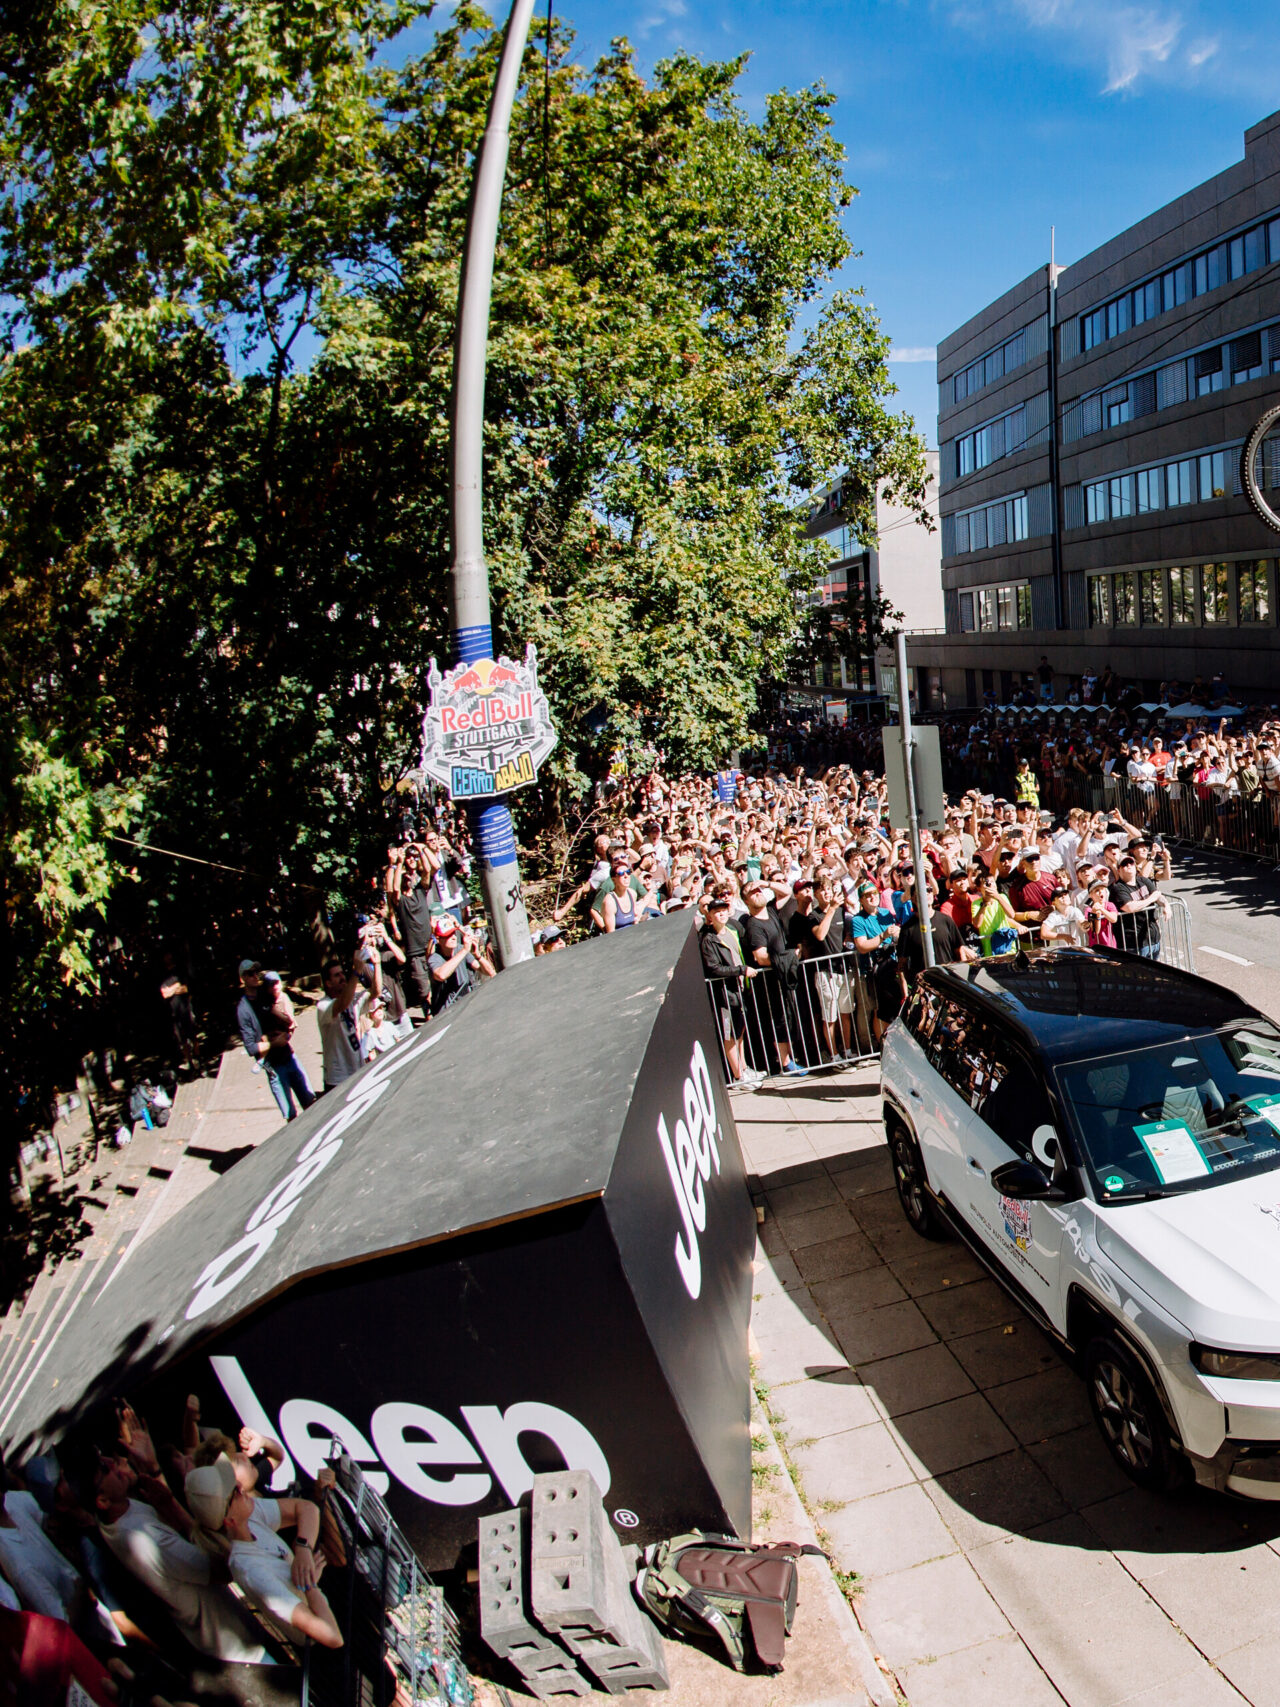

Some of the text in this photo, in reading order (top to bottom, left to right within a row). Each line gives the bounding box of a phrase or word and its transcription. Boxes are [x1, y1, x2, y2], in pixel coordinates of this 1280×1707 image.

[441, 692, 533, 733] Red Bull
[454, 722, 524, 748] STUTTGART
[453, 753, 536, 796] CERRO ABAJO
[658, 1040, 722, 1300] Jeep
[209, 1355, 612, 1507] Jeep
